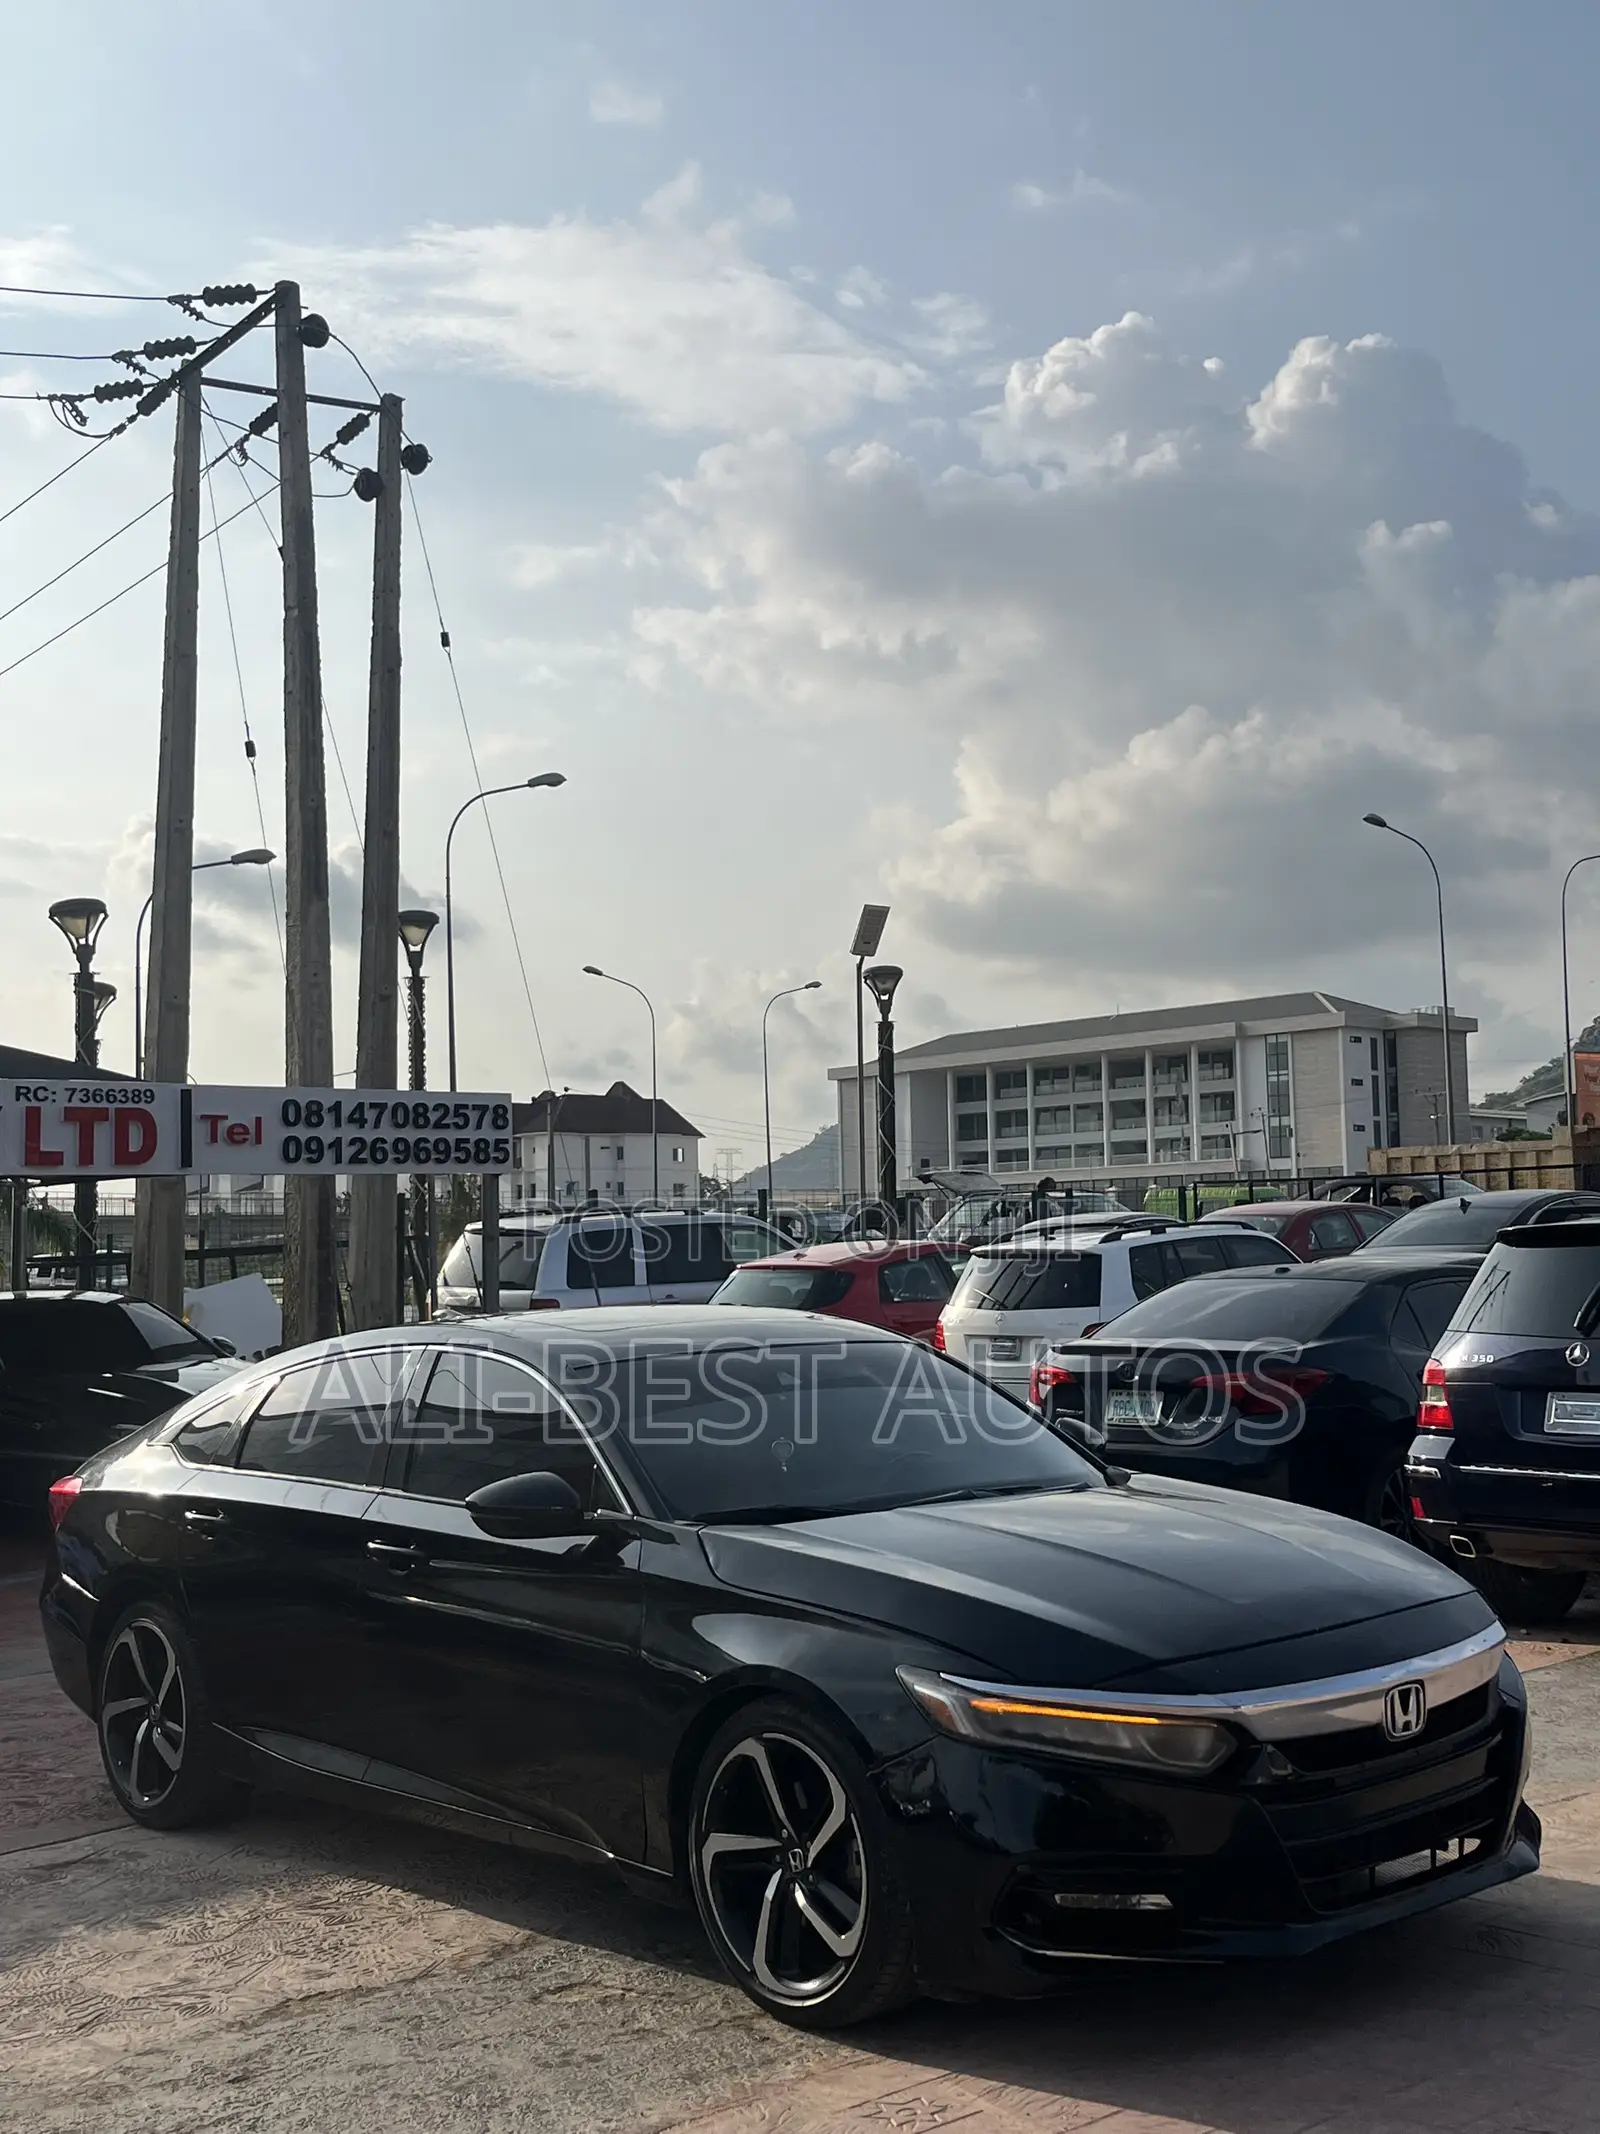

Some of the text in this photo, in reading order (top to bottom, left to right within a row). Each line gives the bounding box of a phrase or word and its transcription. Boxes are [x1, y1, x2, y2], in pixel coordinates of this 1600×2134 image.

[15, 1085, 156, 1104] RC: 7366389
[199, 1114, 263, 1145] Tel
[281, 1098, 510, 1130] 08147082578
[25, 1106, 158, 1166] LTD
[281, 1135, 511, 1165] 09126969585
